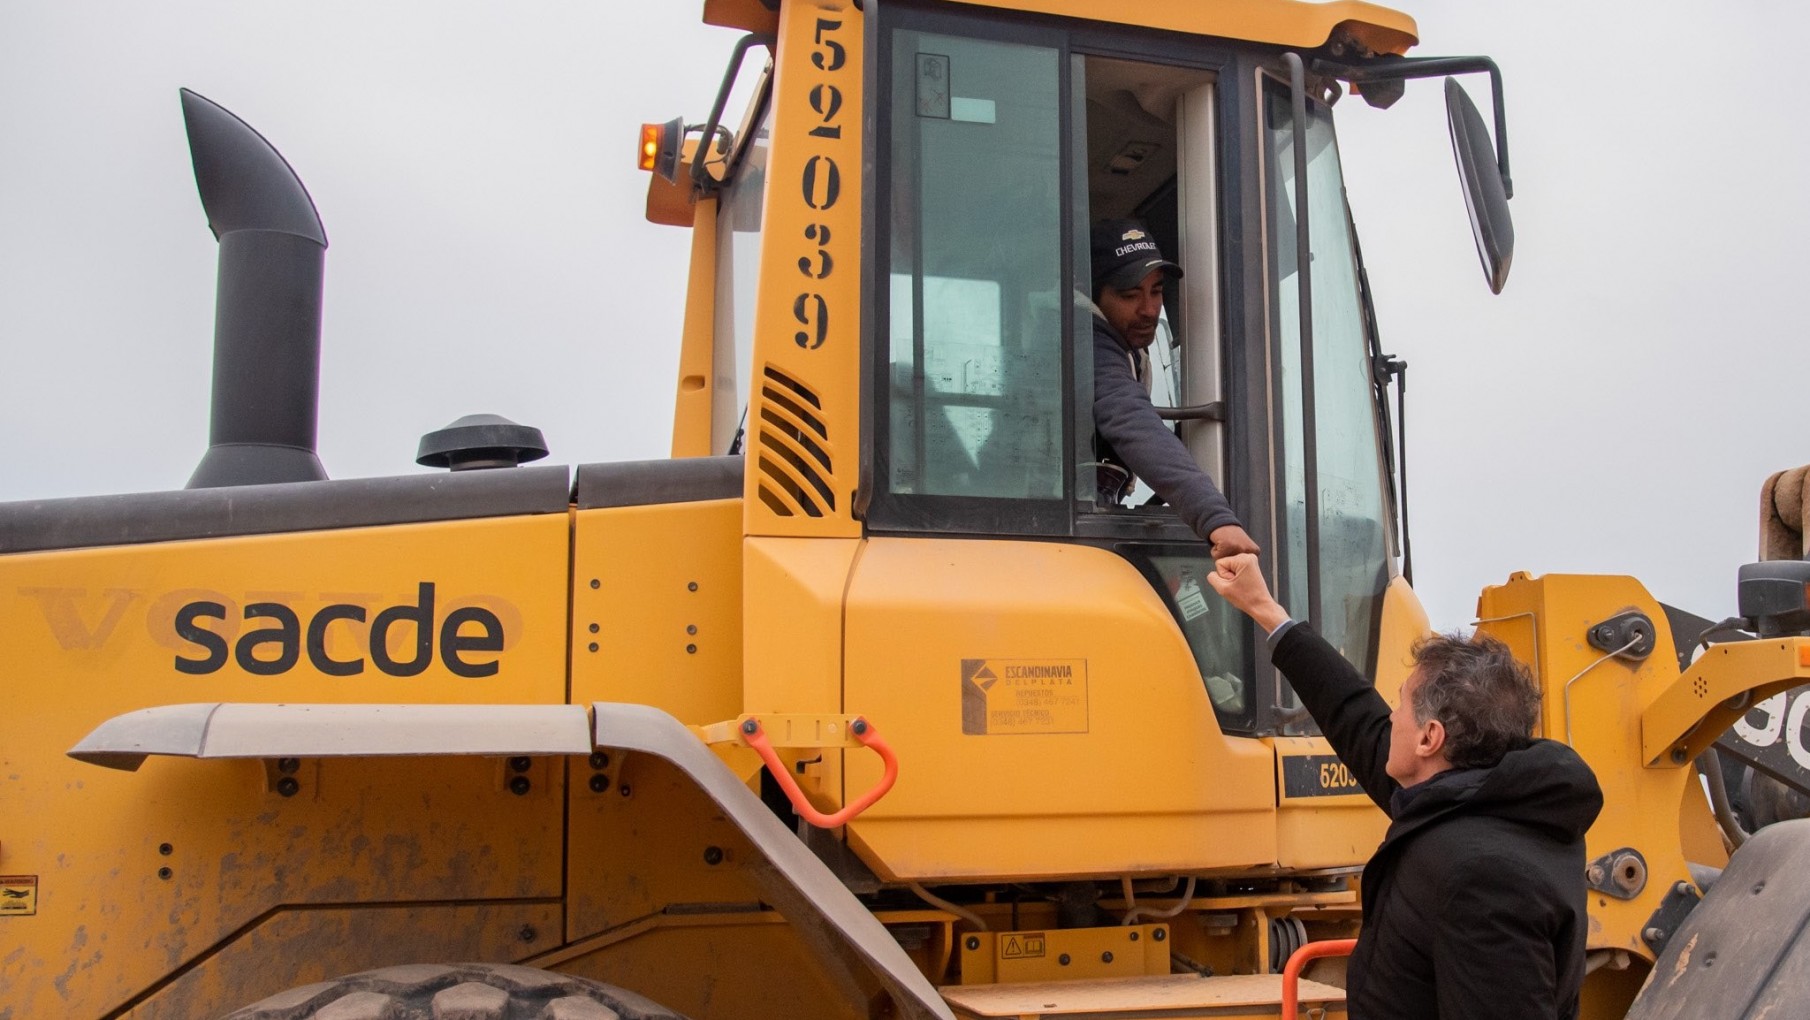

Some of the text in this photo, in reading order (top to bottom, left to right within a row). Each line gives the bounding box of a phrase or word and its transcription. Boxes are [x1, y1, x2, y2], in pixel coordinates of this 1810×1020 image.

[793, 17, 847, 350] 52039
[174, 581, 505, 678] sacde
[1005, 665, 1072, 679] ESCANDINAVIA
[1015, 689, 1054, 697] REPUESTOS
